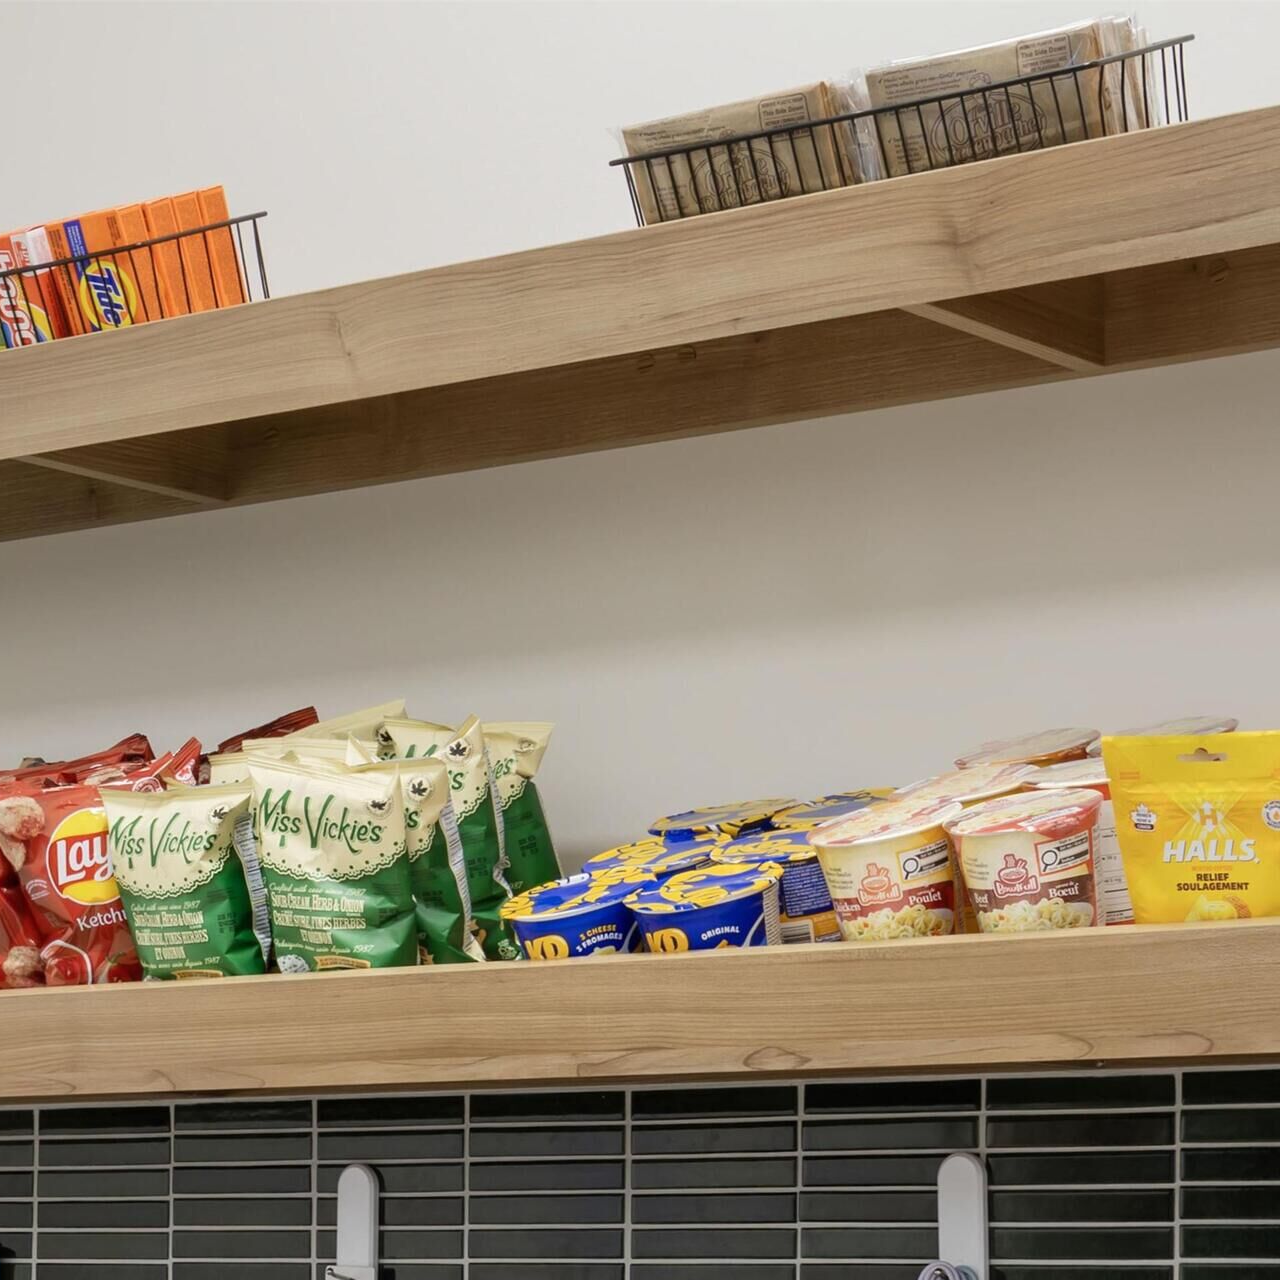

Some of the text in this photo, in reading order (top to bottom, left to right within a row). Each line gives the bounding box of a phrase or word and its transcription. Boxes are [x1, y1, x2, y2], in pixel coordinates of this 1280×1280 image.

[87, 267, 124, 326] Tide
[260, 788, 382, 855] Miss Vickie's
[110, 812, 218, 869] Miss Vickie's
[1163, 838, 1257, 864] HALLS
[1196, 873, 1230, 882] RELIEF
[1176, 882, 1250, 891] SOULAGEMENT
[908, 891, 942, 906] Poulet
[586, 924, 617, 938] CHEESE
[701, 925, 740, 941] ORIGINAL
[582, 932, 623, 949] FROMAGES
